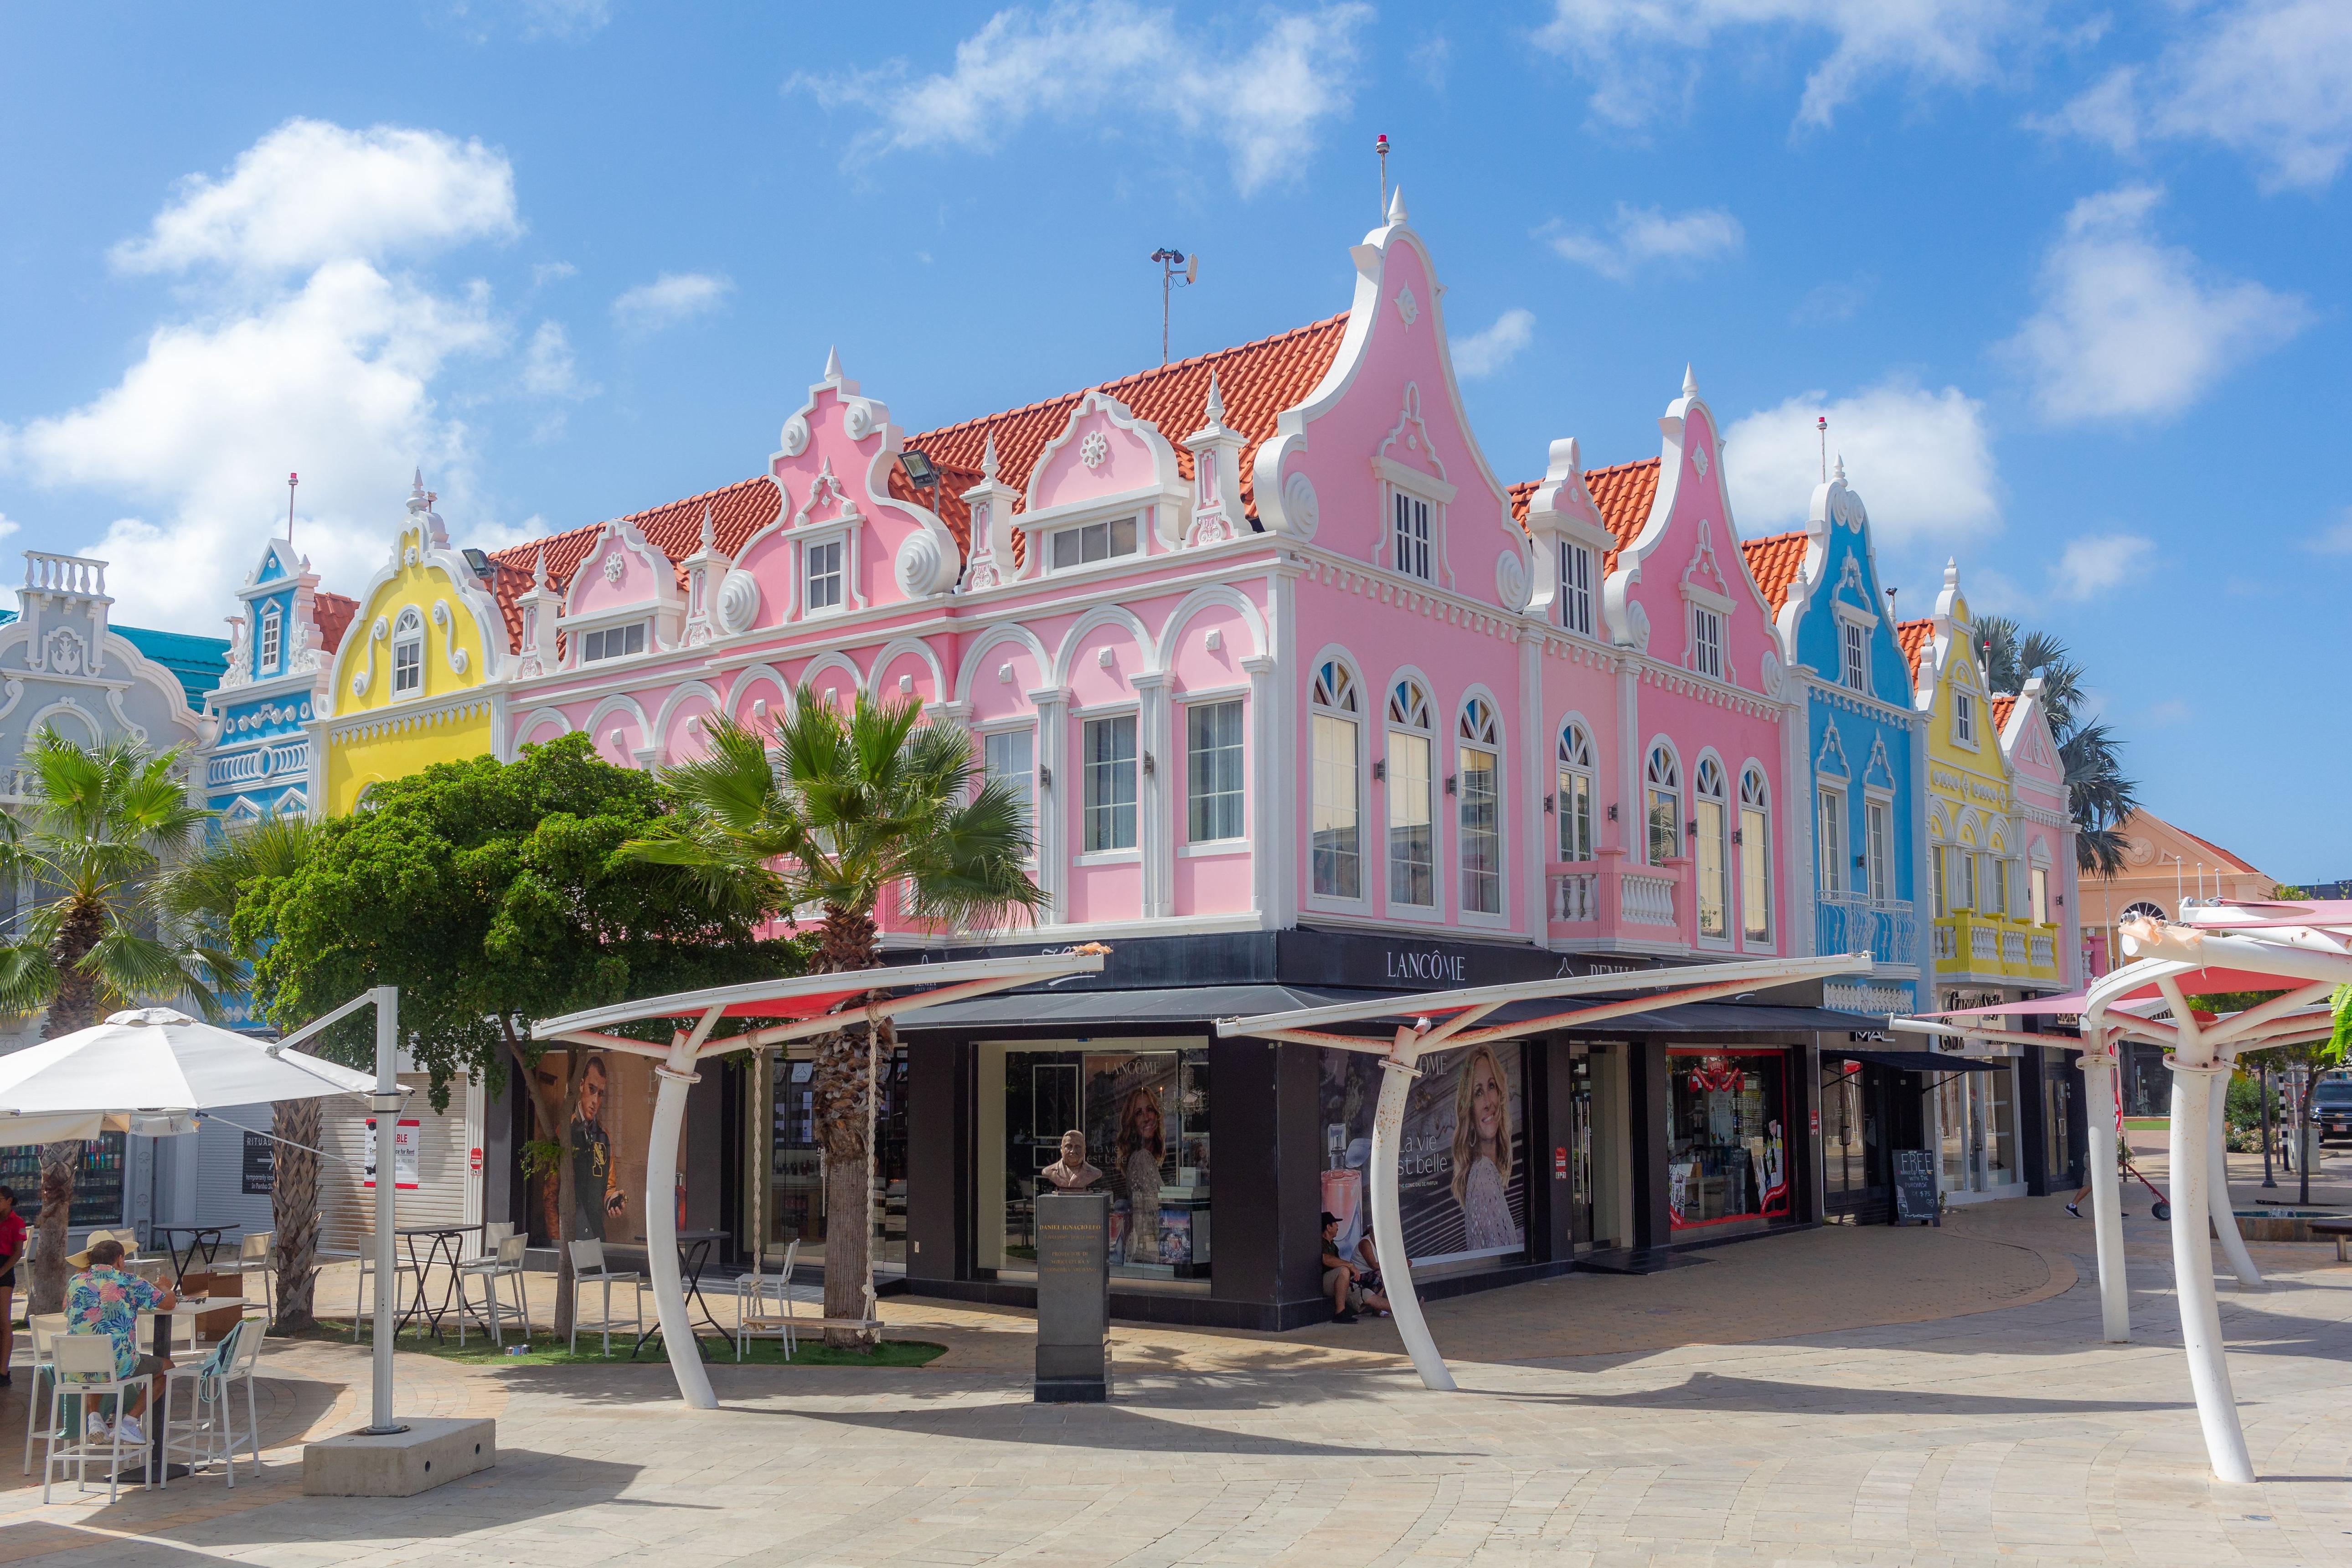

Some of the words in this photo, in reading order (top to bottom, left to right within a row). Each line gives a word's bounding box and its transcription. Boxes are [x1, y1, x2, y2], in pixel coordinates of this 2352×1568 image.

[1105, 1059, 1161, 1074] LANCÔME
[247, 1137, 272, 1145] RITUAL
[396, 1134, 407, 1143] BLE
[1417, 1132, 1436, 1151] vie
[1094, 1144, 1103, 1153] La
[1105, 1144, 1120, 1153] vie
[1398, 1157, 1413, 1176] st
[1417, 1153, 1447, 1174] belle
[1902, 1153, 1933, 1171] FREE
